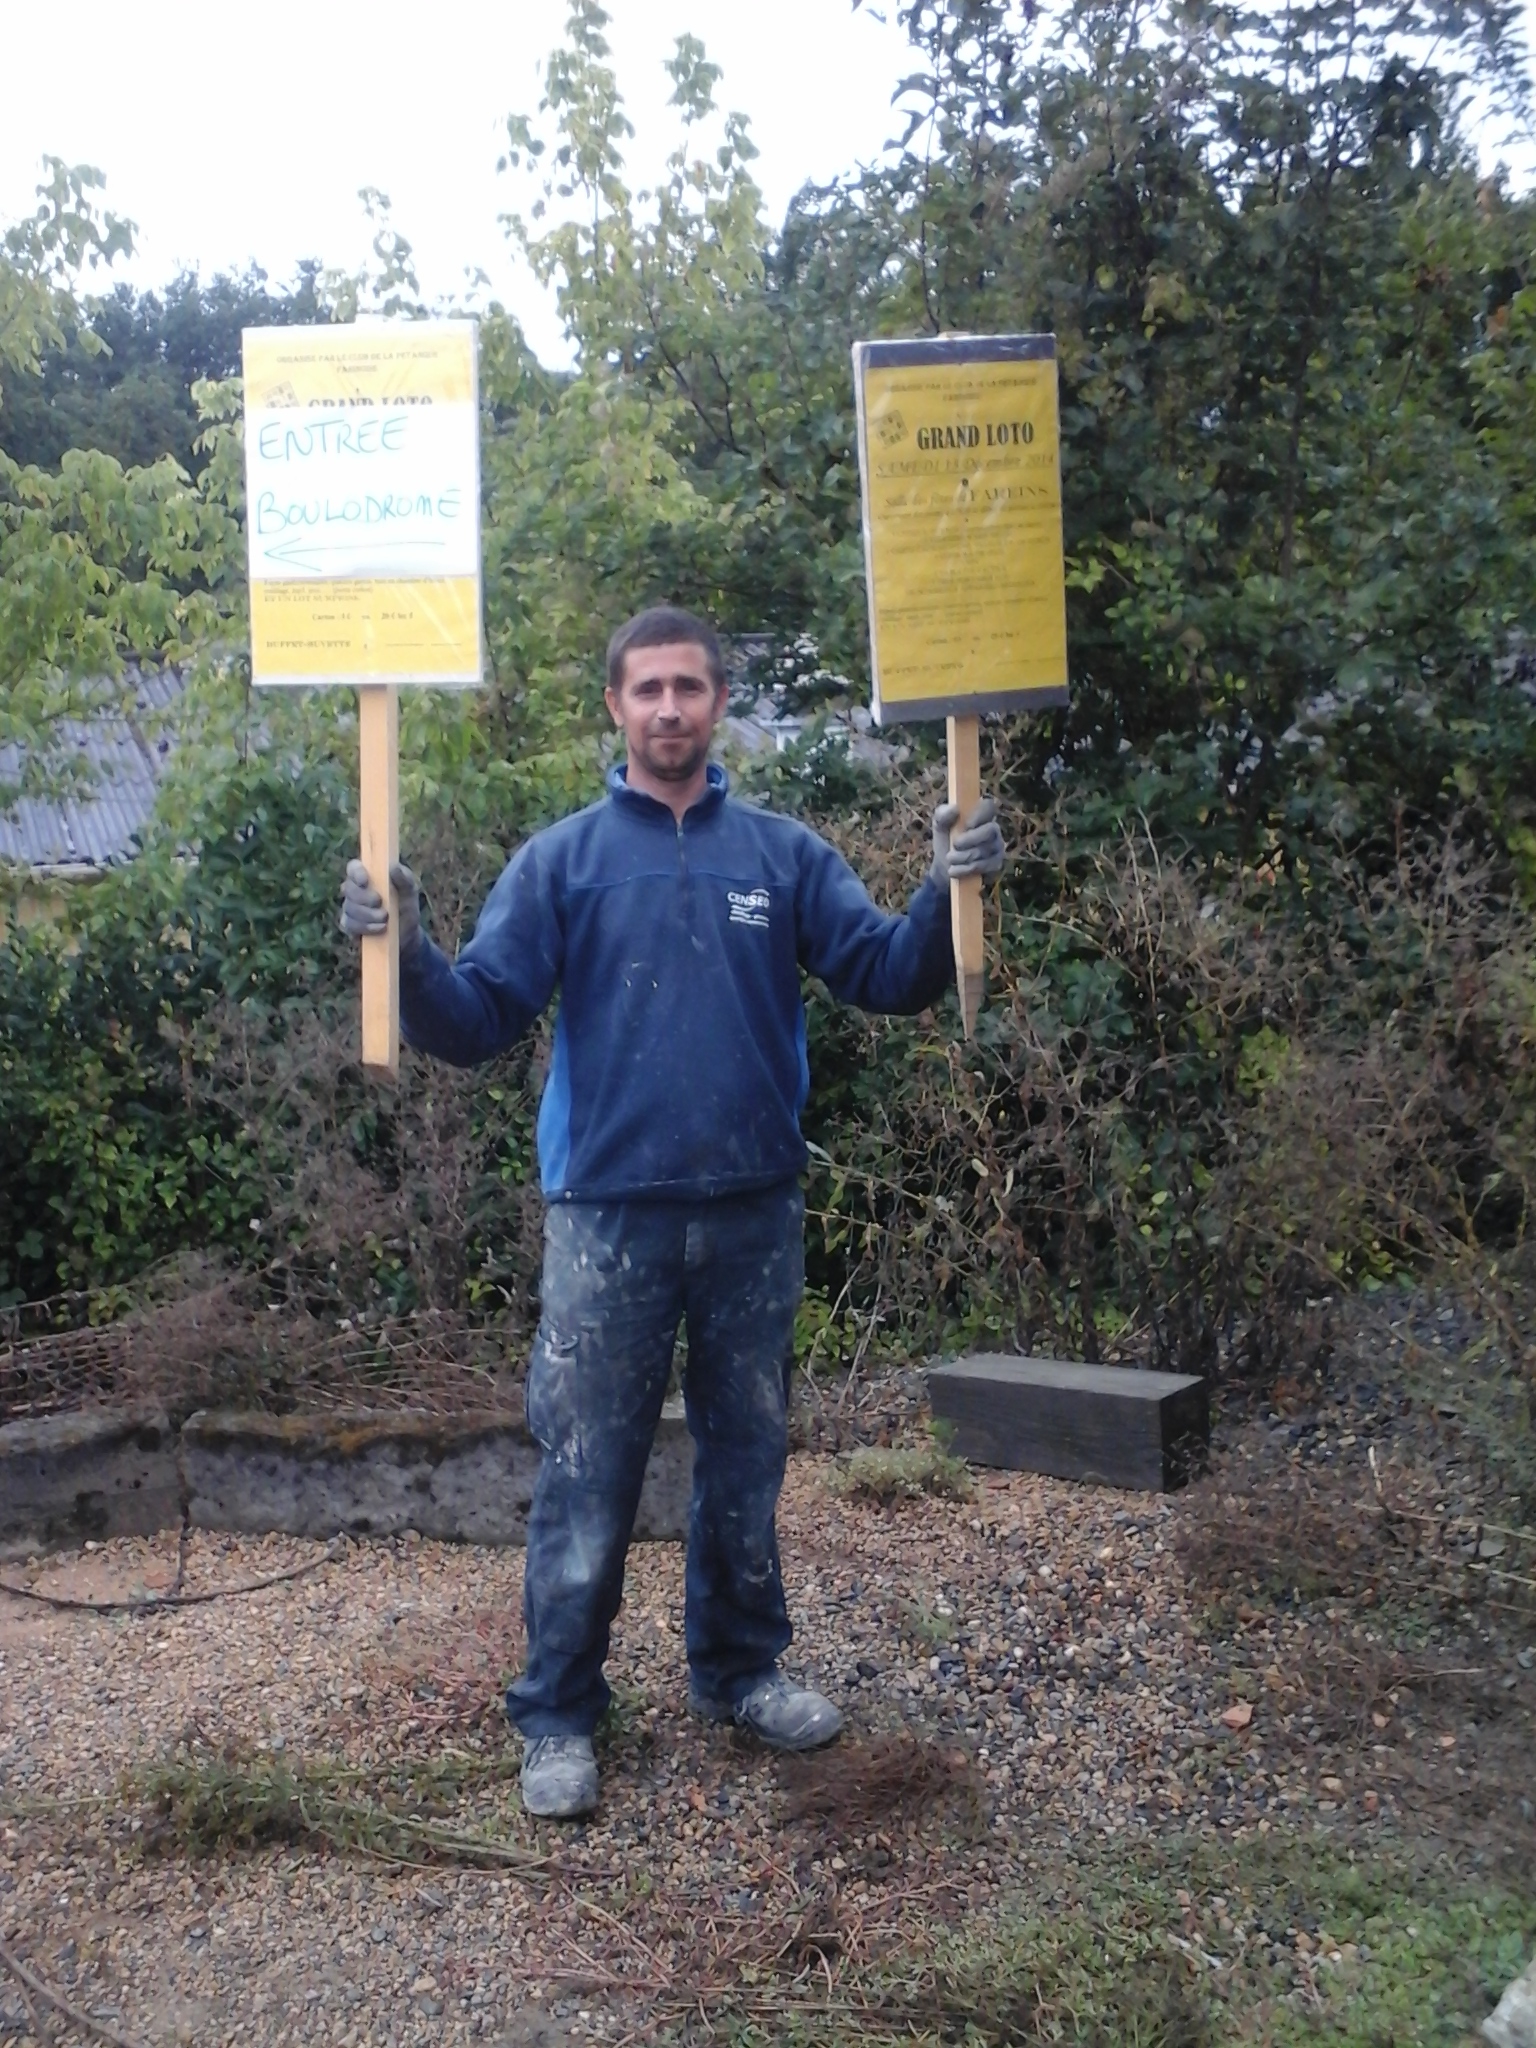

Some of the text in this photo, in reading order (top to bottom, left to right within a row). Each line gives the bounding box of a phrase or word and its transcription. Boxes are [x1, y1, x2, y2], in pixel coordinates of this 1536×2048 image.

[259, 416, 409, 461] ENTREE
[916, 421, 1034, 450] GRAND LOTO
[257, 488, 461, 535] BOULODROME
[727, 891, 770, 908] CENSEO
